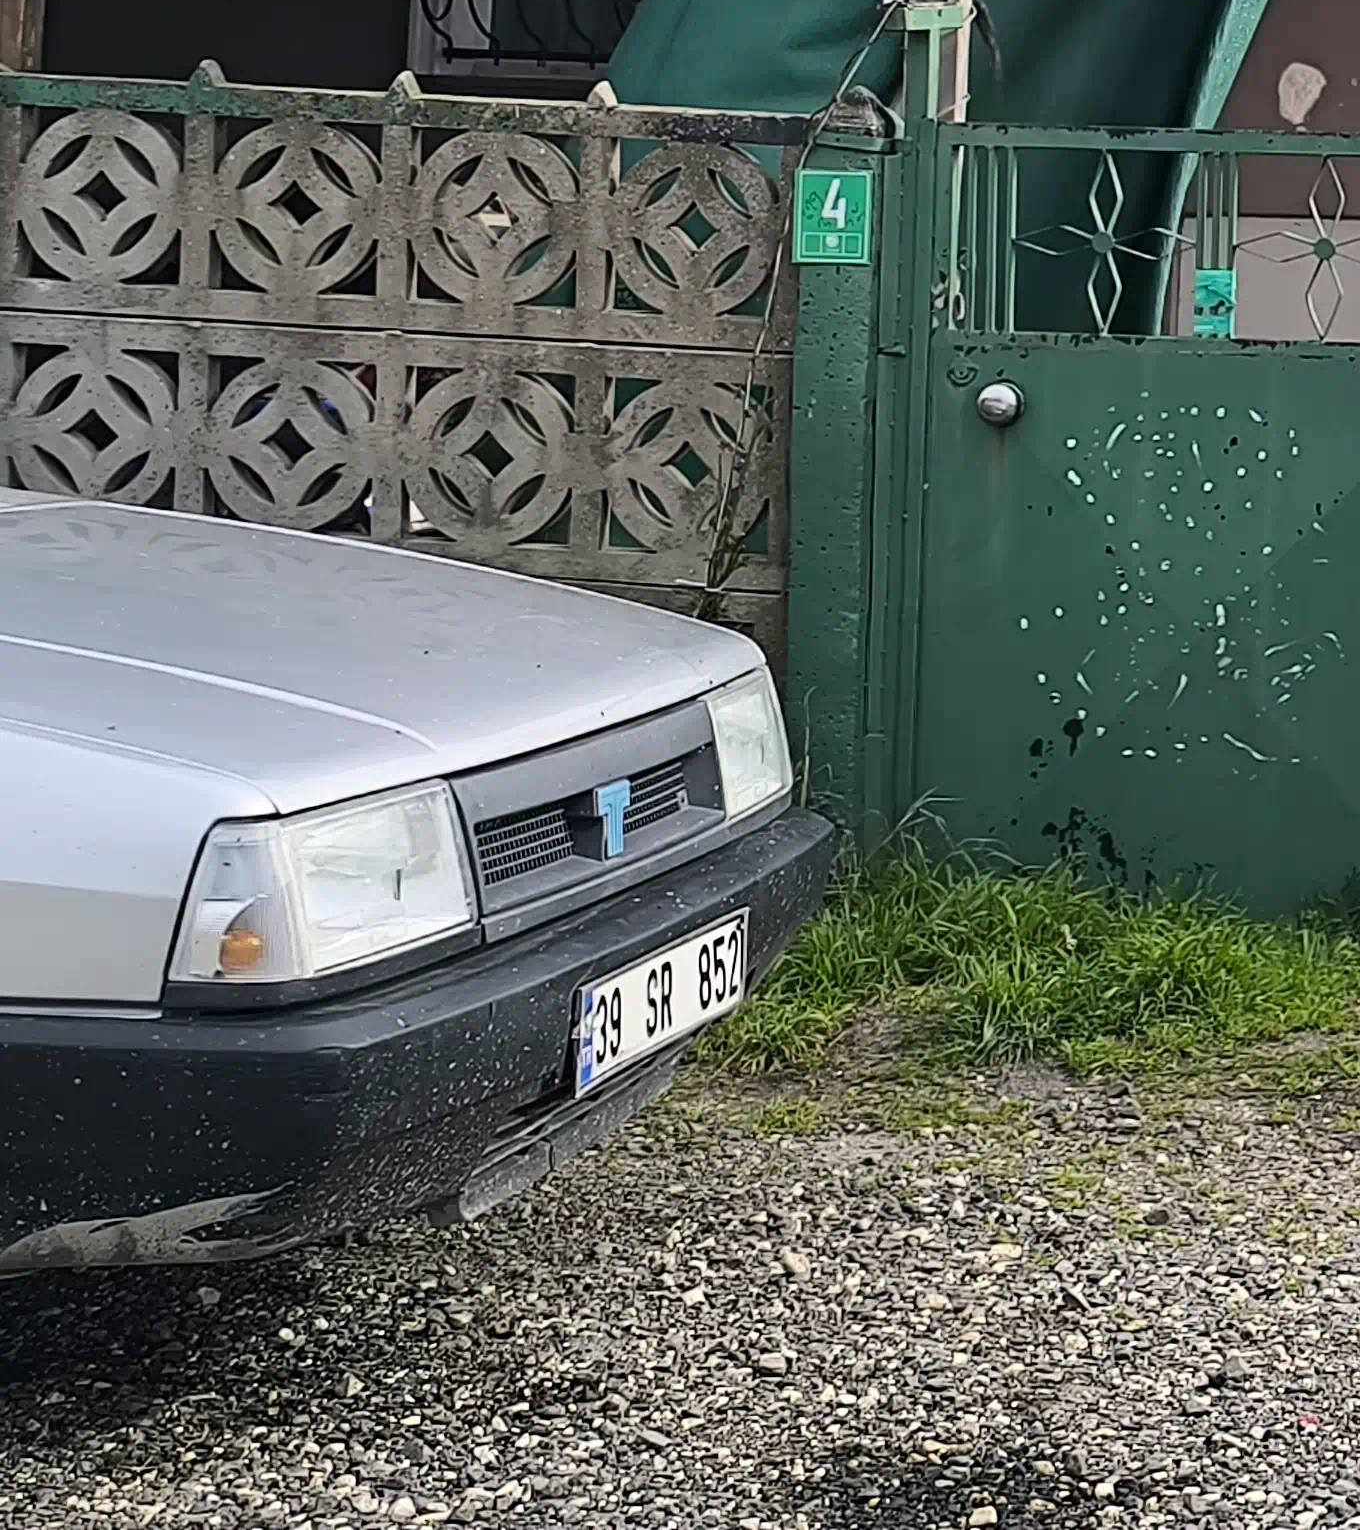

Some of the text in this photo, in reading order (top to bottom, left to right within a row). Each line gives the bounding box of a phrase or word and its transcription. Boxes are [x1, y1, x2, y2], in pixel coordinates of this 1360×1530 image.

[821, 177, 847, 230] 4
[596, 930, 739, 1065] 39 SR 852
